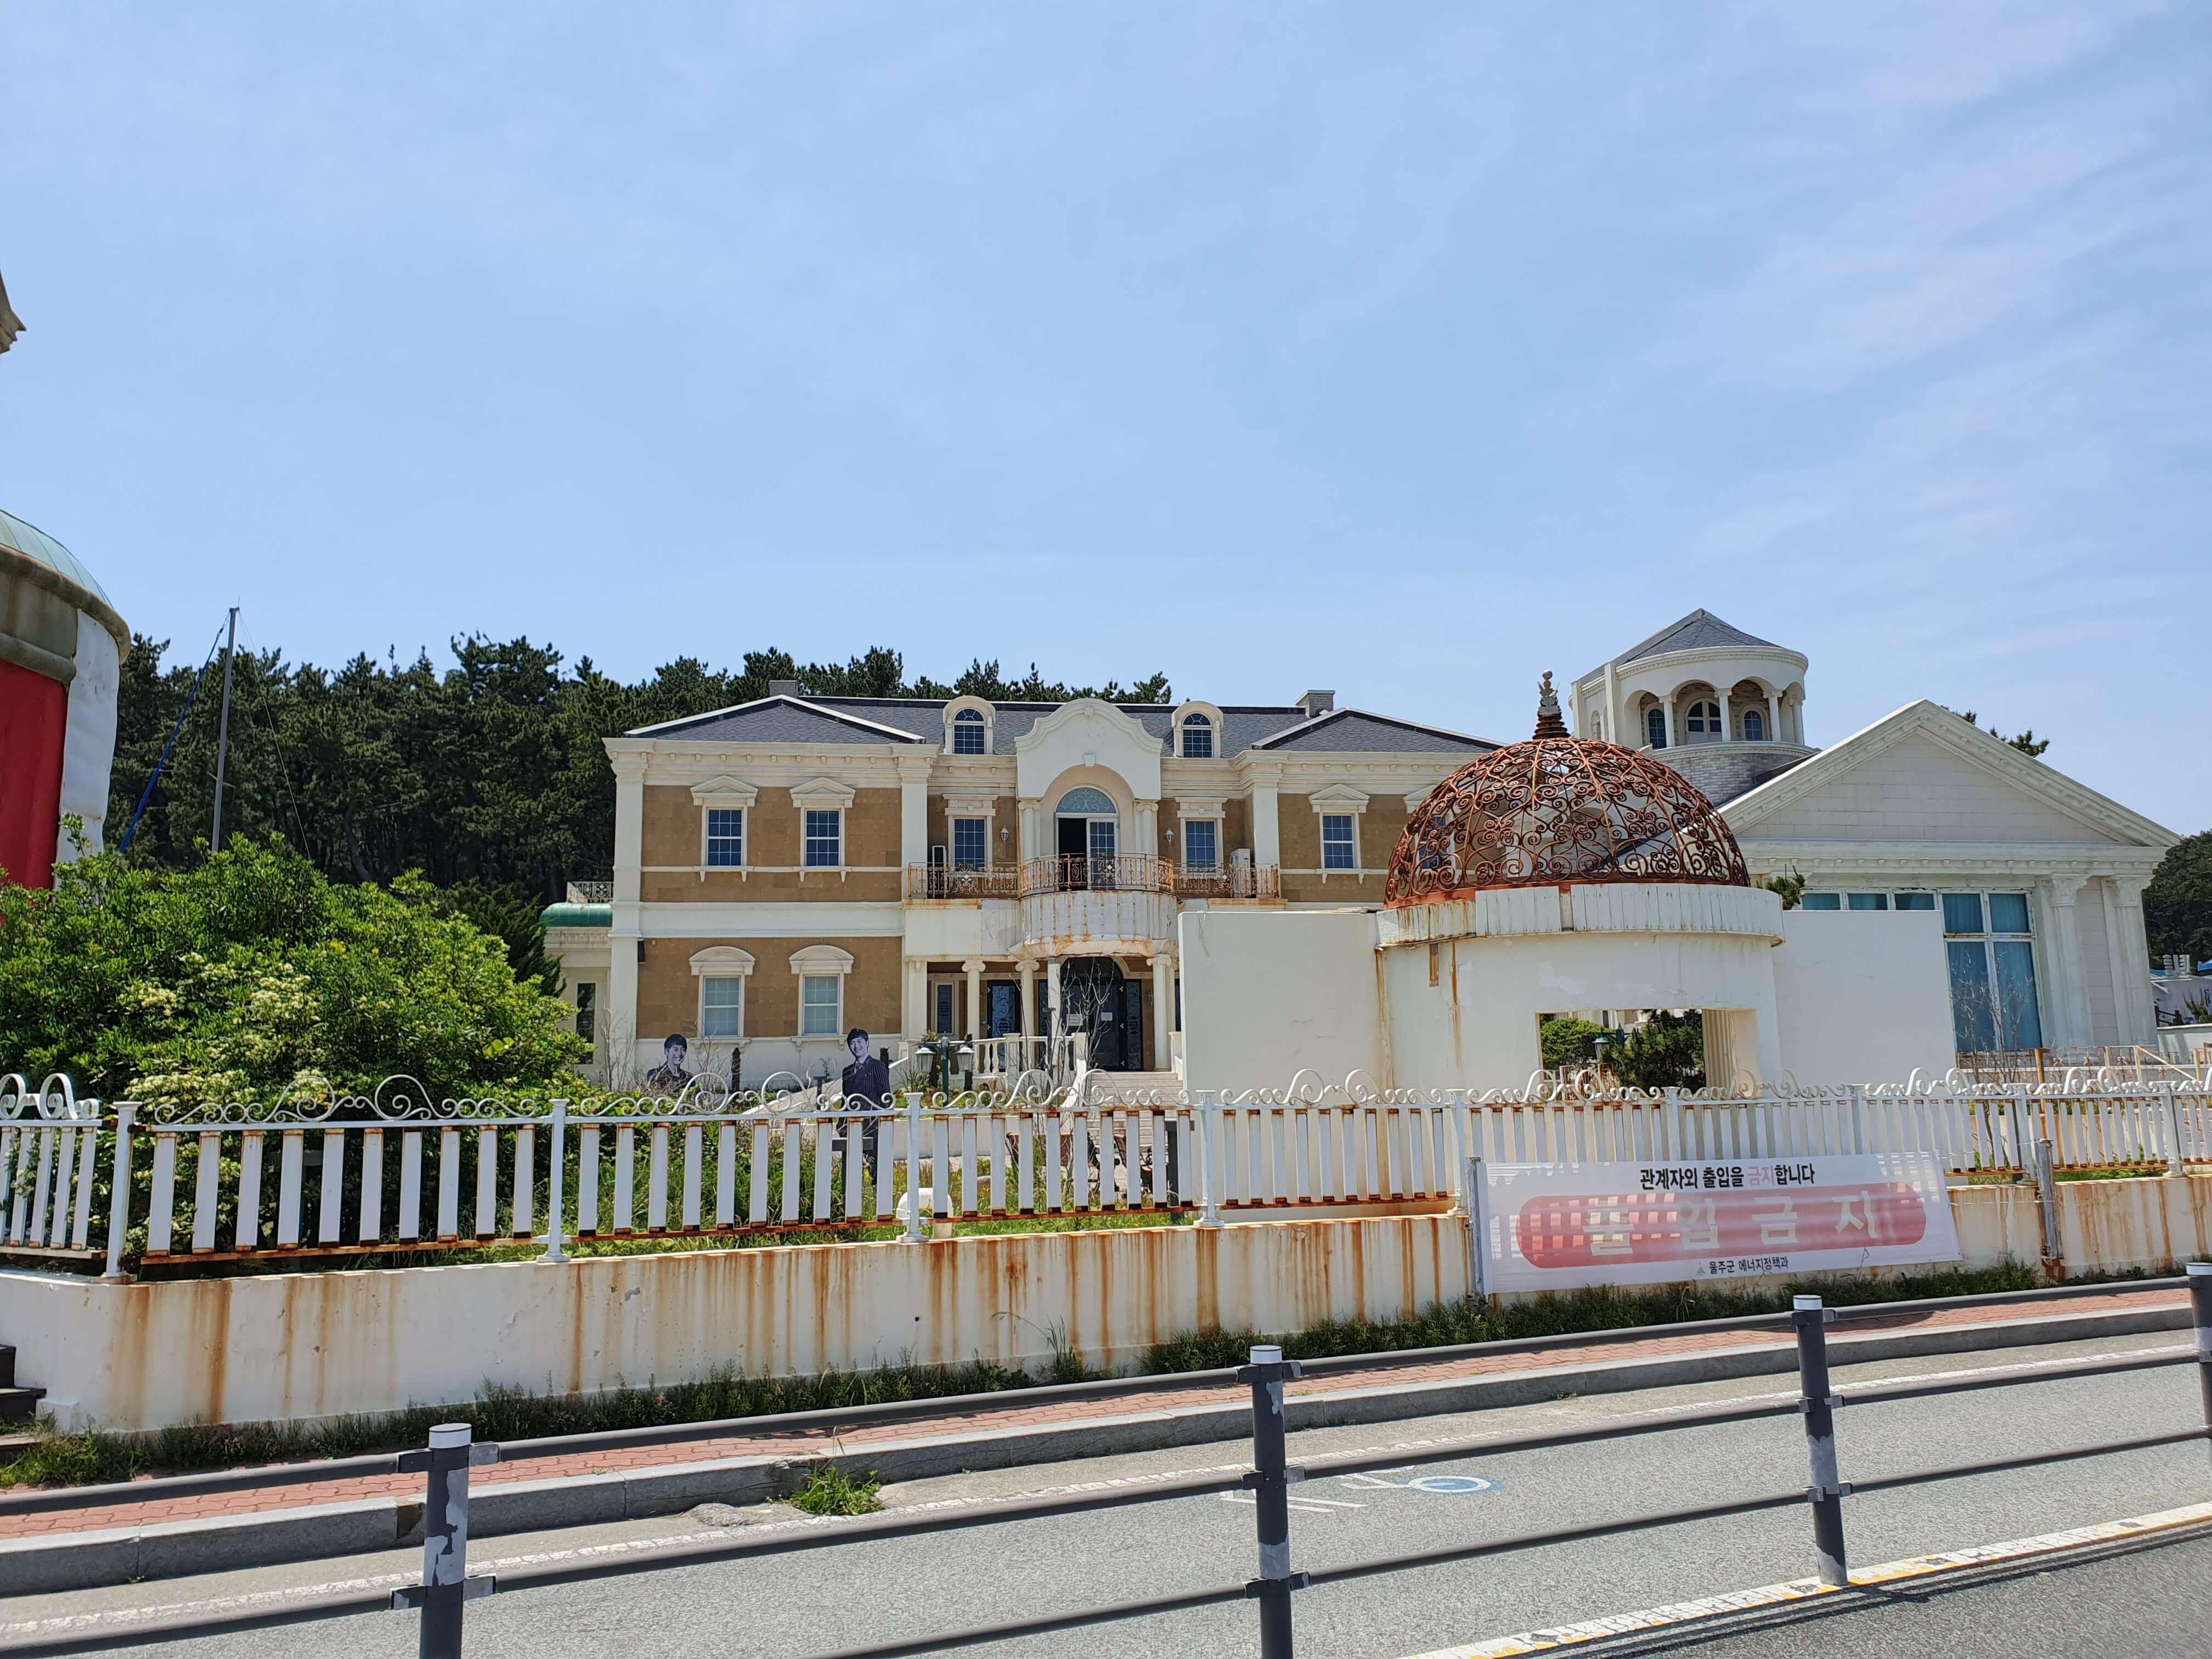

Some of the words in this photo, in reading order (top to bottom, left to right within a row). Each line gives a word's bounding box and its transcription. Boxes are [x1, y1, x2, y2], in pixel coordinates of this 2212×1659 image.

[1640, 1168, 1698, 1190] 관계자외
[1702, 1166, 1743, 1188] 출입을
[1748, 1163, 1815, 1185] 금지합니다
[1709, 1261, 1735, 1274] 울주군
[1738, 1256, 1788, 1272] 에너지정책과
